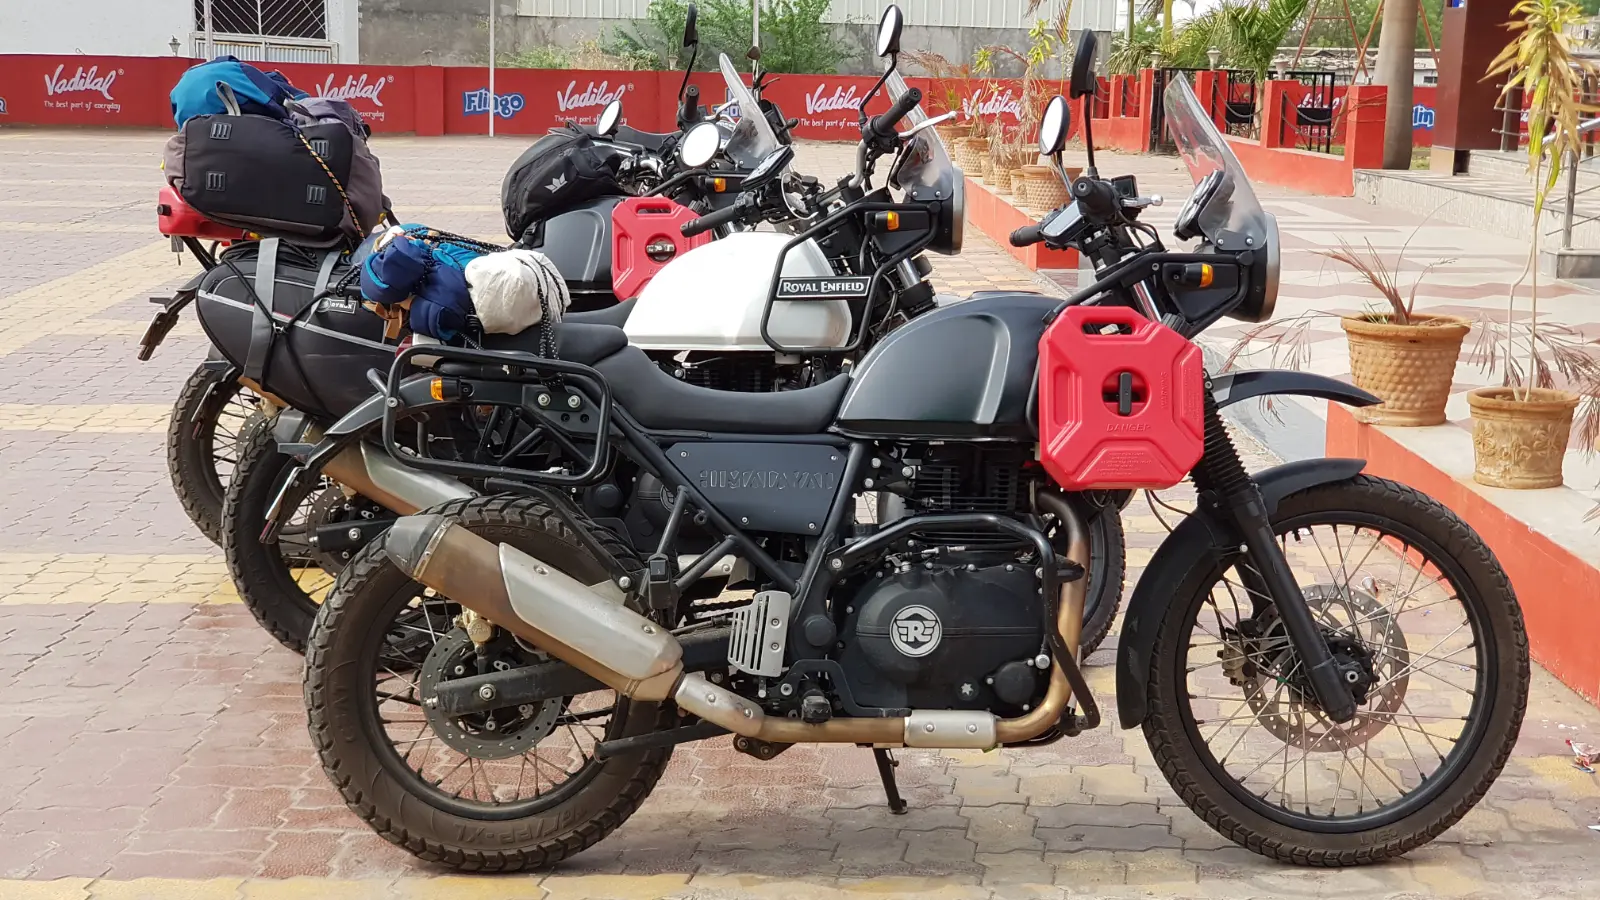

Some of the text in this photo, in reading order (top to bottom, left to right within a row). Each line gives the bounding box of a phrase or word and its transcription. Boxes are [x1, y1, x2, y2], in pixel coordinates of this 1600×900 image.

[44, 64, 117, 100] Vadilal
[315, 73, 386, 107] Vadilal
[70, 102, 83, 111] part
[85, 101, 92, 111] of
[94, 103, 121, 113] everyday
[800, 118, 811, 127] The
[812, 118, 824, 127] best
[826, 119, 838, 130] part
[839, 118, 847, 130] of
[783, 281, 864, 293] ROYAL ENFIELD
